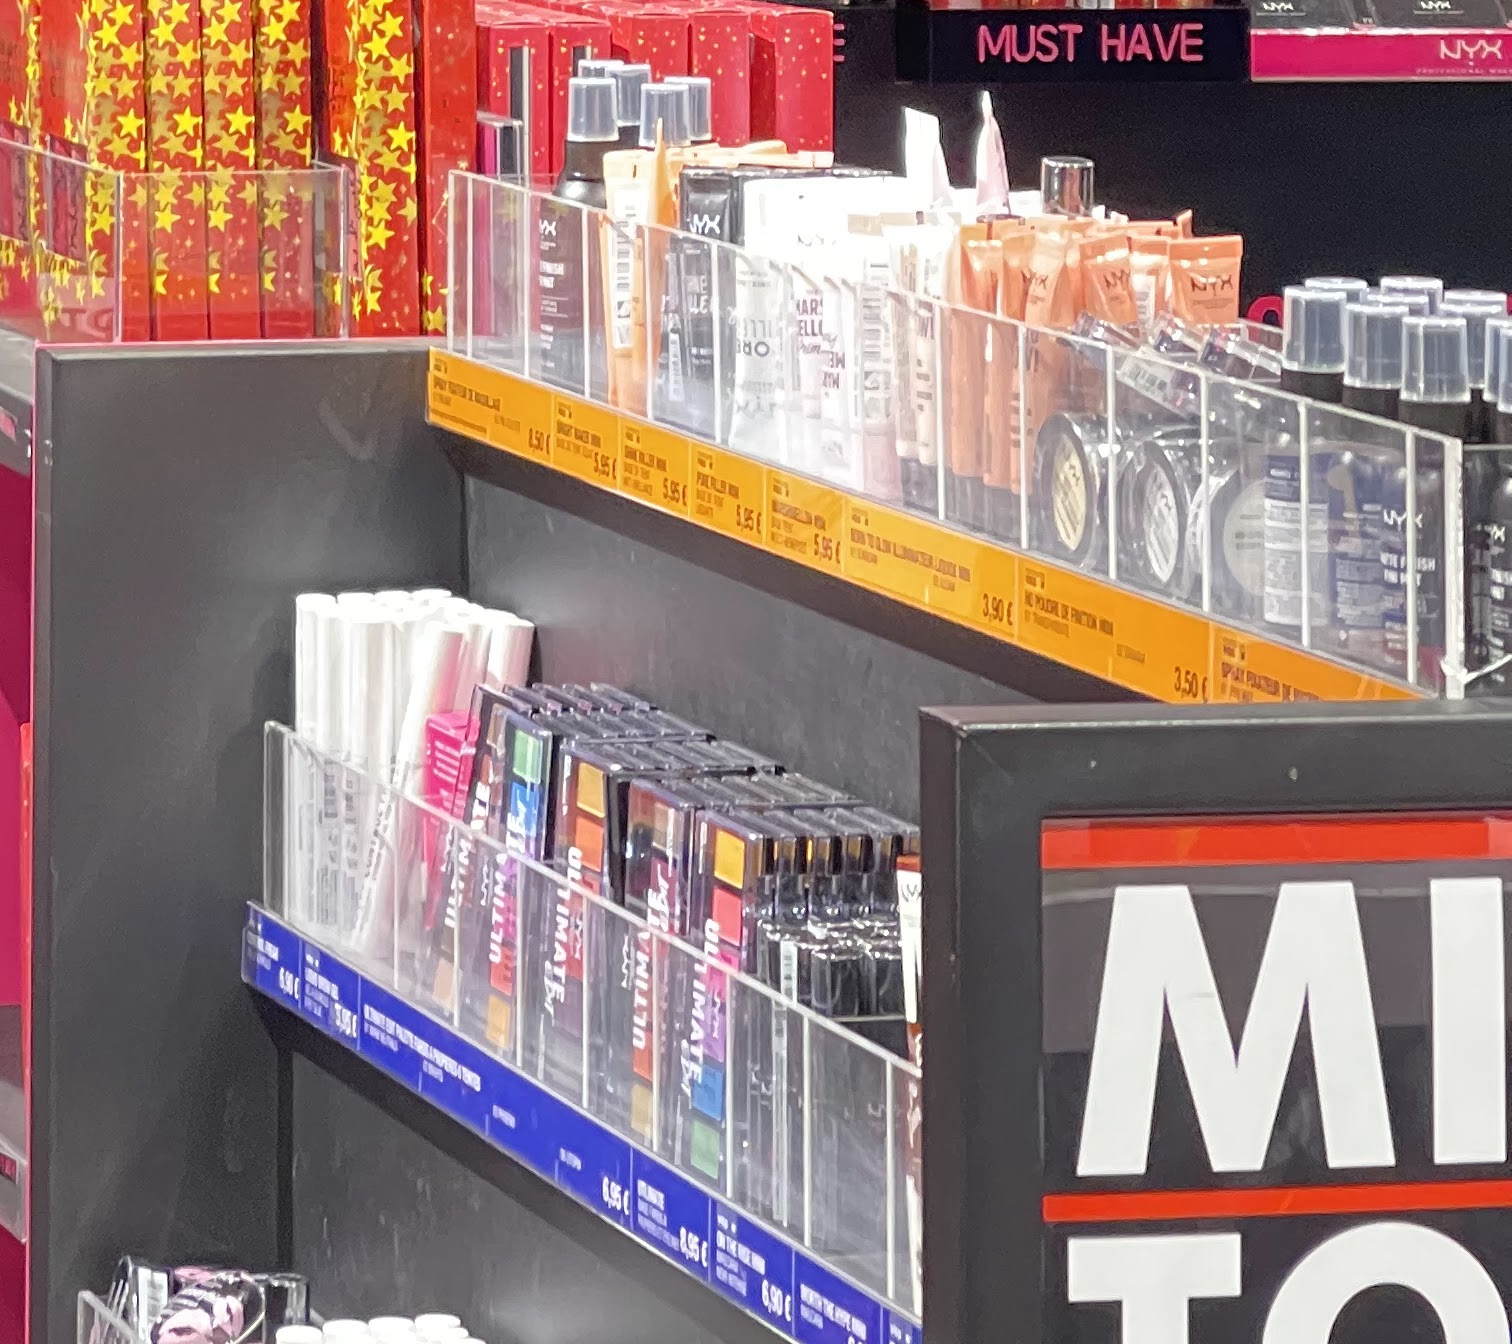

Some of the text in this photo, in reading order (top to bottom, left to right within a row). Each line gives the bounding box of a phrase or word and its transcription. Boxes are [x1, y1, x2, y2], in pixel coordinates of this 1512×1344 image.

[977, 23, 1204, 63] MUST HAVE
[1439, 39, 1502, 60] NYX
[1076, 877, 1507, 1175] MI
